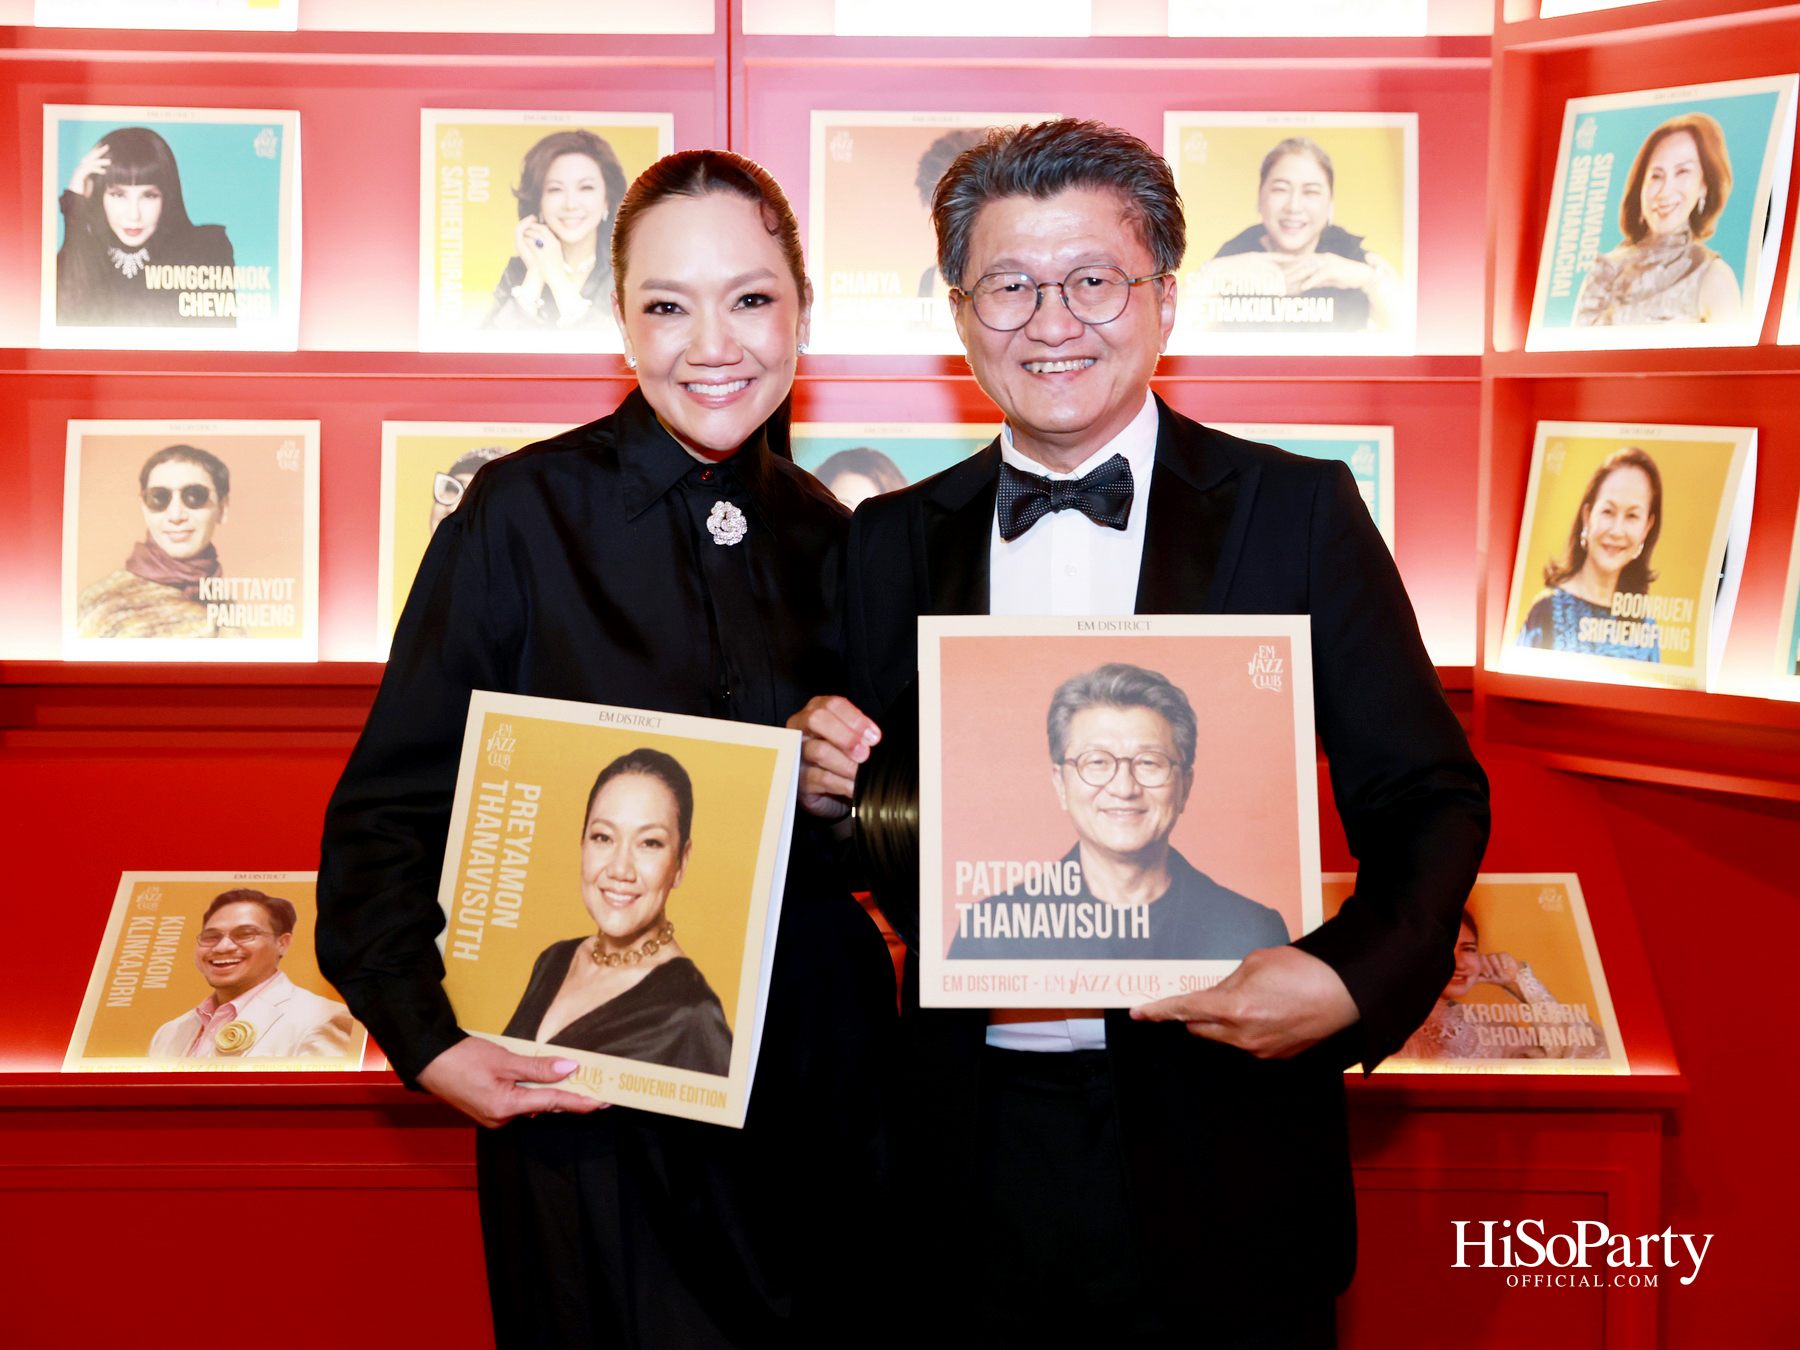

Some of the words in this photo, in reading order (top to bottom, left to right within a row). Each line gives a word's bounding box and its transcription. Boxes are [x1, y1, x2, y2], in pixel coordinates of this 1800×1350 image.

[467, 166, 490, 203] DAO
[1575, 152, 1614, 274] SUTHAVADEE
[1549, 155, 1592, 298] SIRITHANACHAI
[145, 265, 271, 290] WONGCHANOK
[831, 271, 900, 296] CHANYA
[179, 292, 271, 317] CHEVASIRI
[199, 577, 295, 600] KRITTAYOT
[207, 603, 295, 627] PAIRUENG
[1611, 592, 1694, 623] BOONRUEN
[1077, 621, 1095, 631] EM
[1098, 621, 1151, 631] DISTRICT
[1578, 617, 1690, 652] SRIFUENGFUNG
[1248, 653, 1283, 675] JAZZ
[1258, 645, 1275, 659] EM
[1253, 674, 1283, 692] CLUB
[498, 723, 512, 737] EM
[599, 711, 615, 722] EM
[616, 713, 662, 729] DISTRICT
[486, 730, 516, 752] JAZZ
[487, 751, 511, 771] CLUB
[491, 783, 541, 929] PREYAMON
[453, 780, 508, 961] THANAVISUTH
[956, 860, 1081, 896] PATPONG
[955, 903, 1149, 938] THANAVISUTH
[106, 916, 156, 1007] KLINKAJORN
[142, 916, 186, 989] KUNAKOM
[942, 975, 962, 992] EM
[967, 975, 1028, 992] DISTRICT
[1044, 975, 1064, 992] EM
[1069, 967, 1111, 994] JAZZ
[1116, 972, 1160, 1000] CLUB
[1477, 1026, 1596, 1047] CHOMANAN
[618, 1072, 676, 1099] SOUVENIR
[679, 1085, 727, 1109] EDITION
